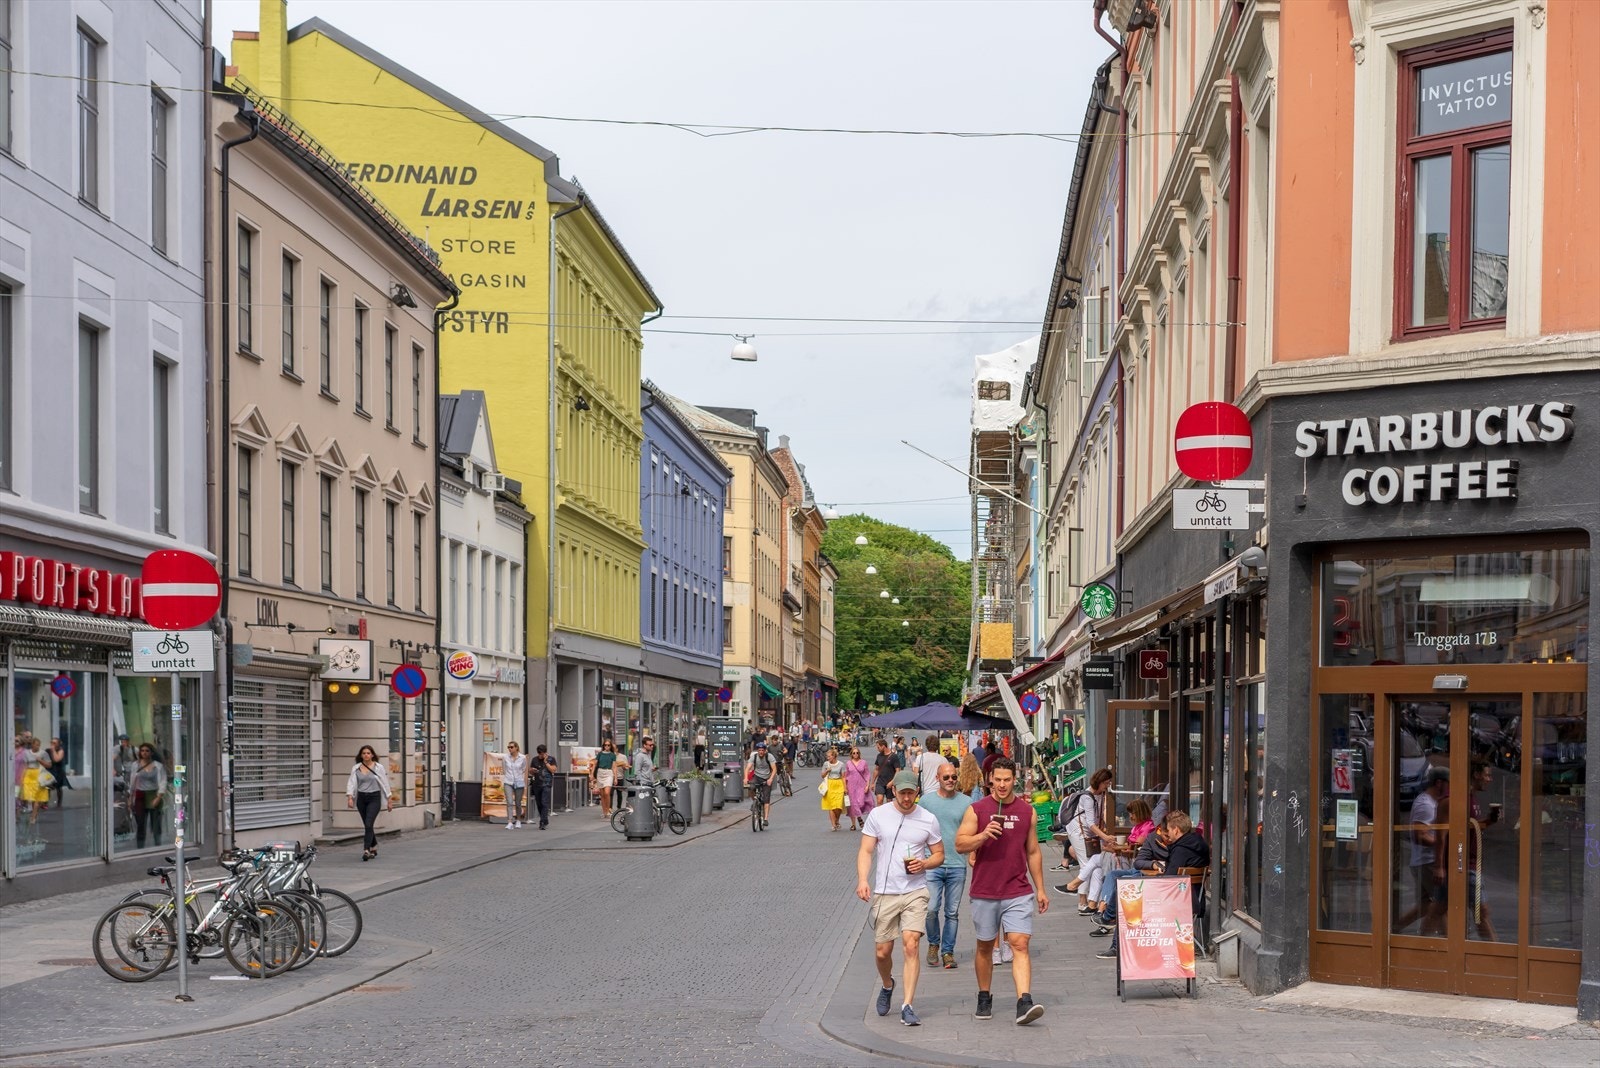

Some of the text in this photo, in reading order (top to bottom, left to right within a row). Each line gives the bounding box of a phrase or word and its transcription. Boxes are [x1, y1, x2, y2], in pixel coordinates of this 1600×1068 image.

[1422, 71, 1512, 102] INVICTUS
[1437, 93, 1497, 116] TATTOO
[420, 188, 523, 219] LARSEN
[441, 239, 516, 254] STORE
[1294, 401, 1570, 458] STARBUCKS
[1341, 459, 1516, 506] COFFEE
[1190, 515, 1232, 526] unntatt
[0, 553, 145, 620] PORTSLA
[1414, 631, 1470, 651] Torggata
[151, 657, 196, 669] unntatt
[449, 655, 473, 667] BURGER
[450, 661, 474, 674] KING
[1126, 928, 1161, 937] INFUSED
[1137, 937, 1174, 947] ICED TEA
